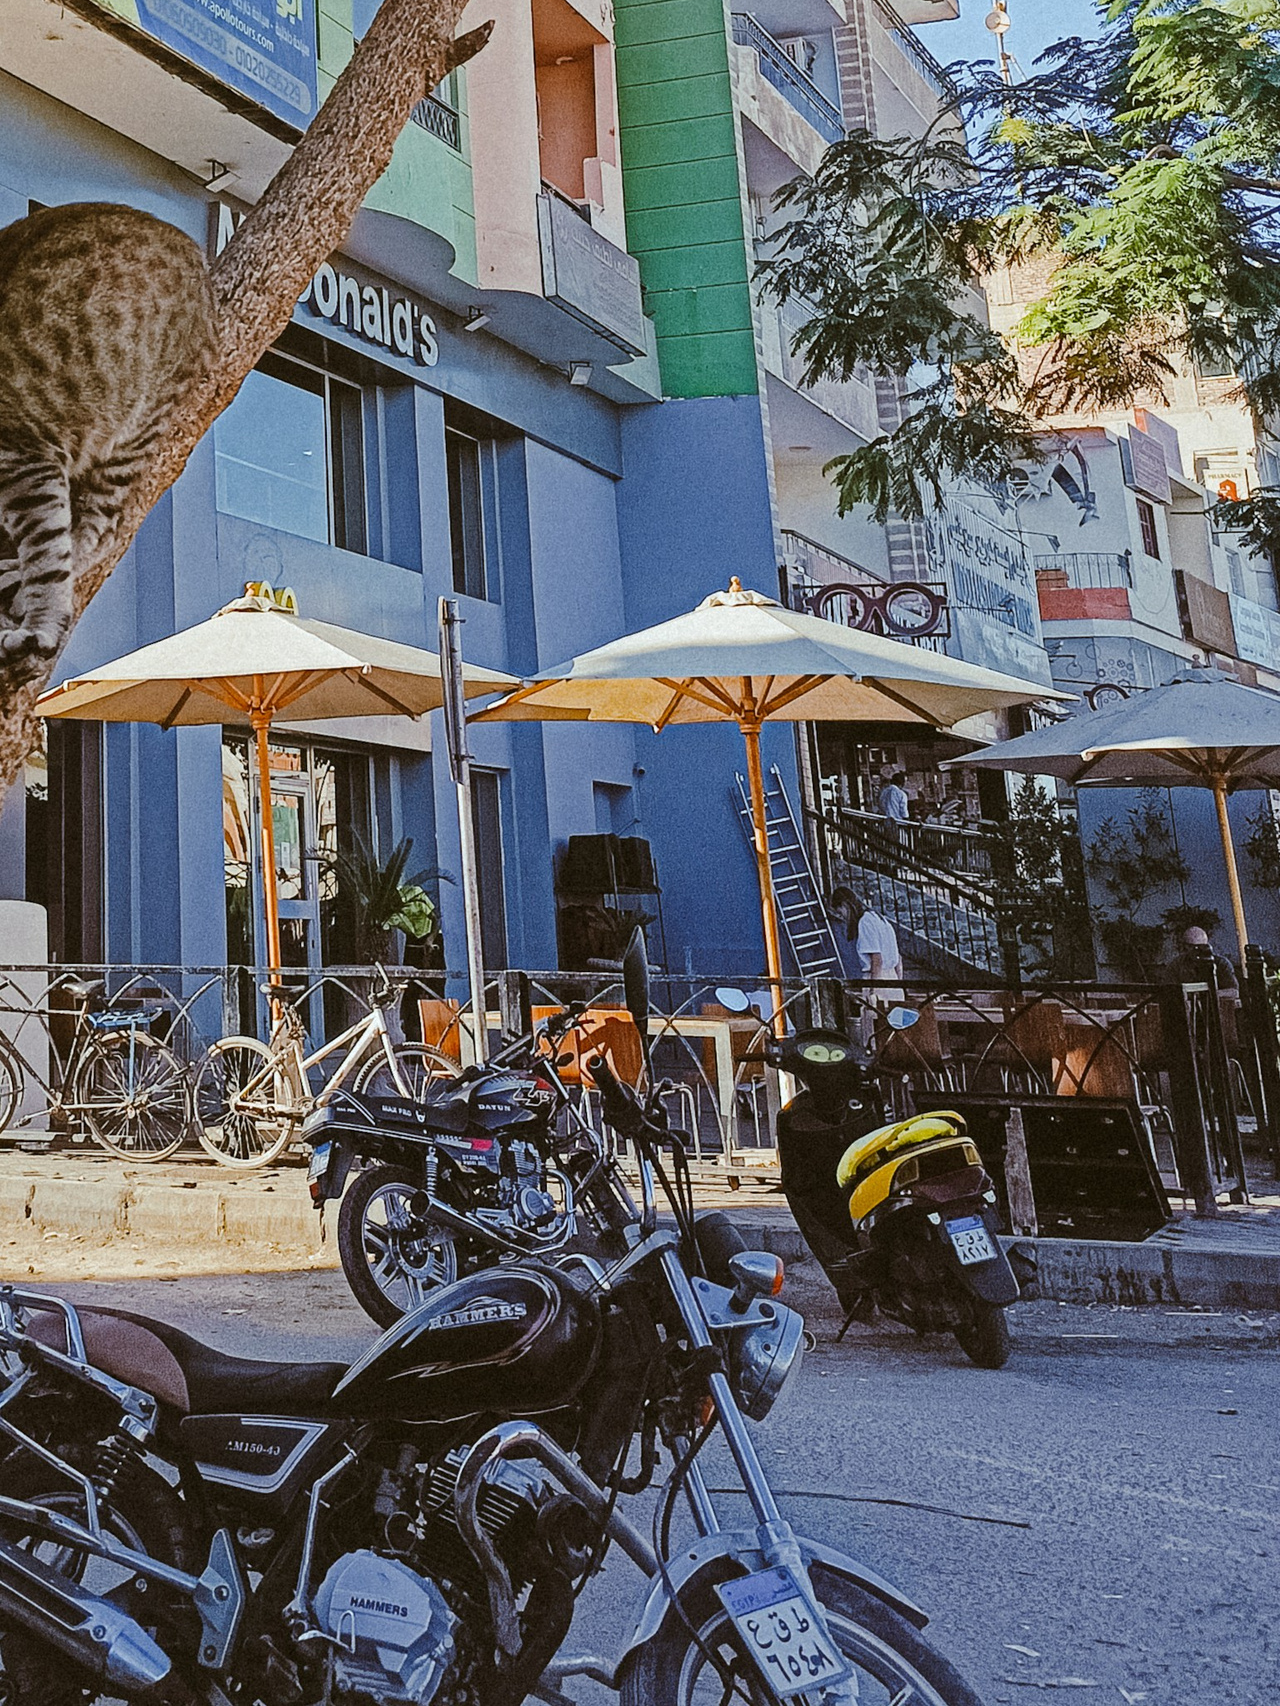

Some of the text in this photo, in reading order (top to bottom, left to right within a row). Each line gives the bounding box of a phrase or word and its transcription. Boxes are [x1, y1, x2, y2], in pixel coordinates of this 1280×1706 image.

[216, 200, 440, 367] Monald's
[382, 1104, 412, 1117] MAX PRO
[429, 1301, 527, 1331] HAMMERS
[349, 1596, 409, 1618] HAMMERS
